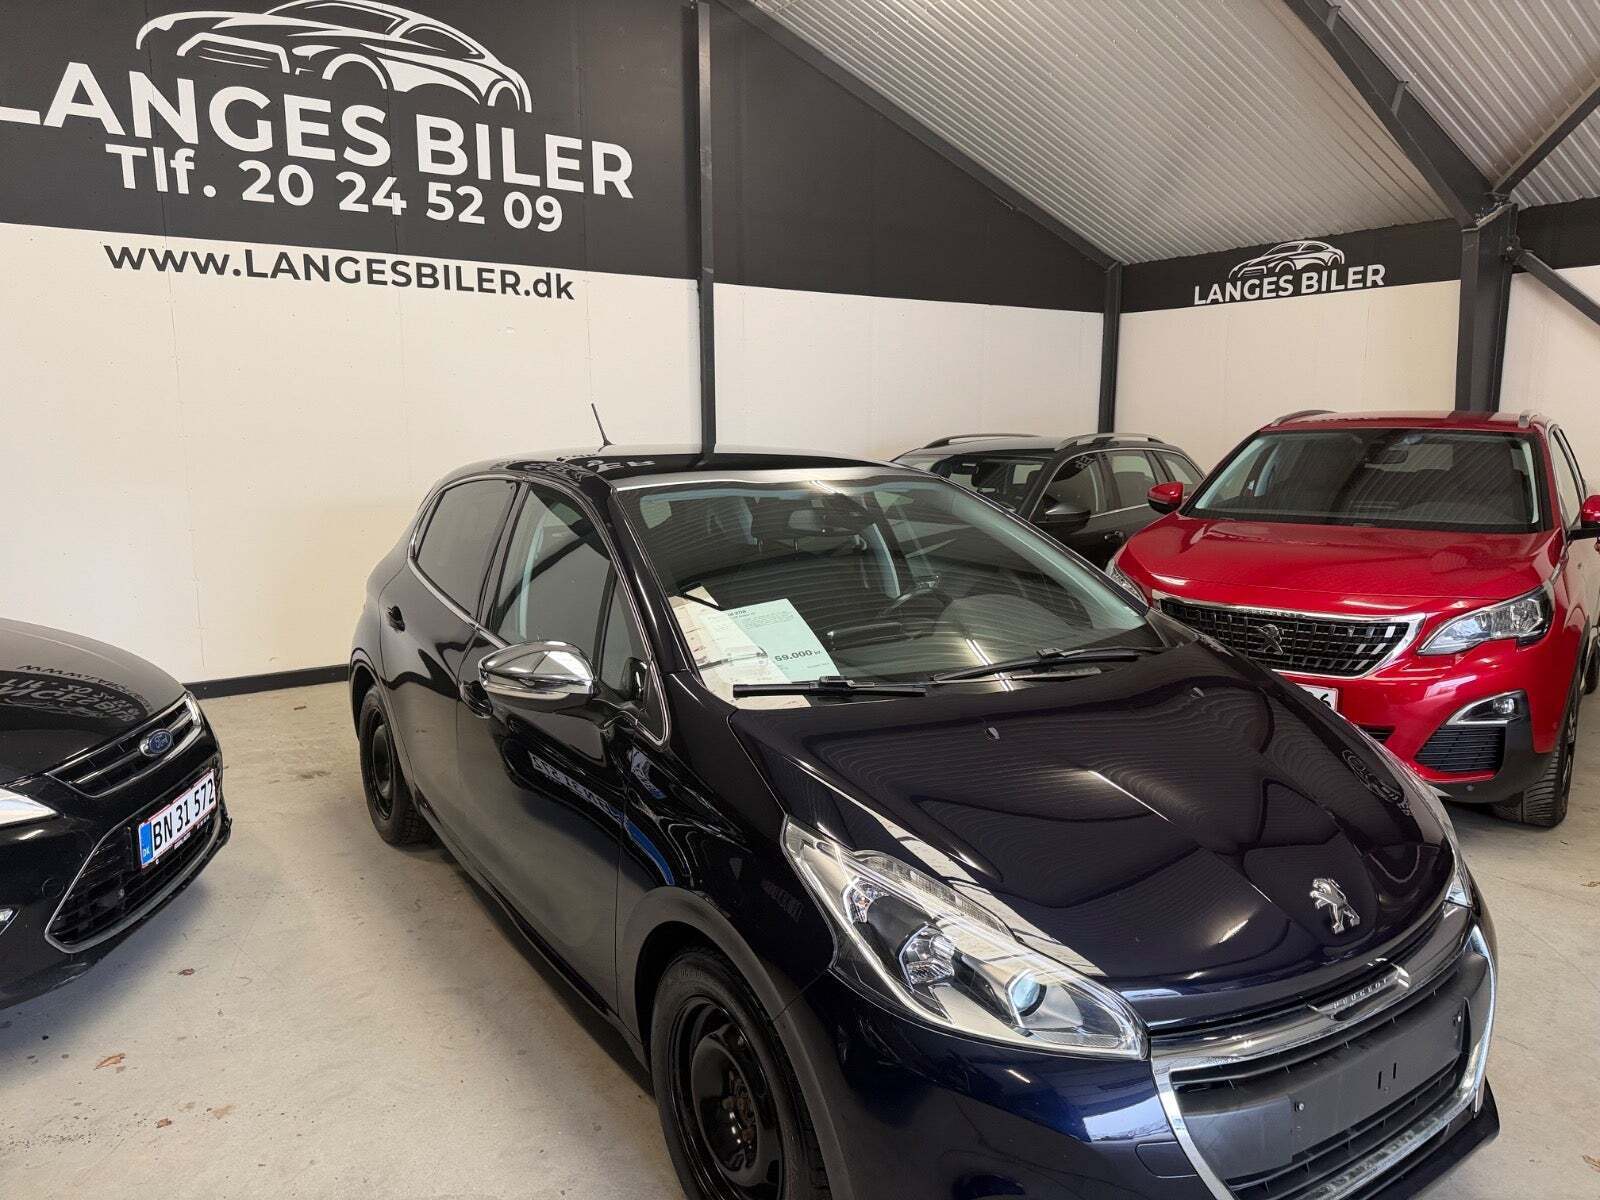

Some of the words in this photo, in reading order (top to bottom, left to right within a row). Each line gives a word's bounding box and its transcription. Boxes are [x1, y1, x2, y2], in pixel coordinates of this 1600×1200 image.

[105, 143, 217, 197] Tlf.
[239, 159, 314, 206] 20
[336, 170, 407, 215] 24
[426, 182, 486, 224] 52
[503, 190, 563, 232] 09
[417, 113, 633, 198] BILER
[104, 244, 574, 300] www.LANGESBILER.dk
[1194, 275, 1293, 305] LANGES
[1301, 264, 1386, 294] BILER
[153, 815, 173, 850] BN
[175, 800, 191, 832] 31
[194, 779, 214, 817] 572
